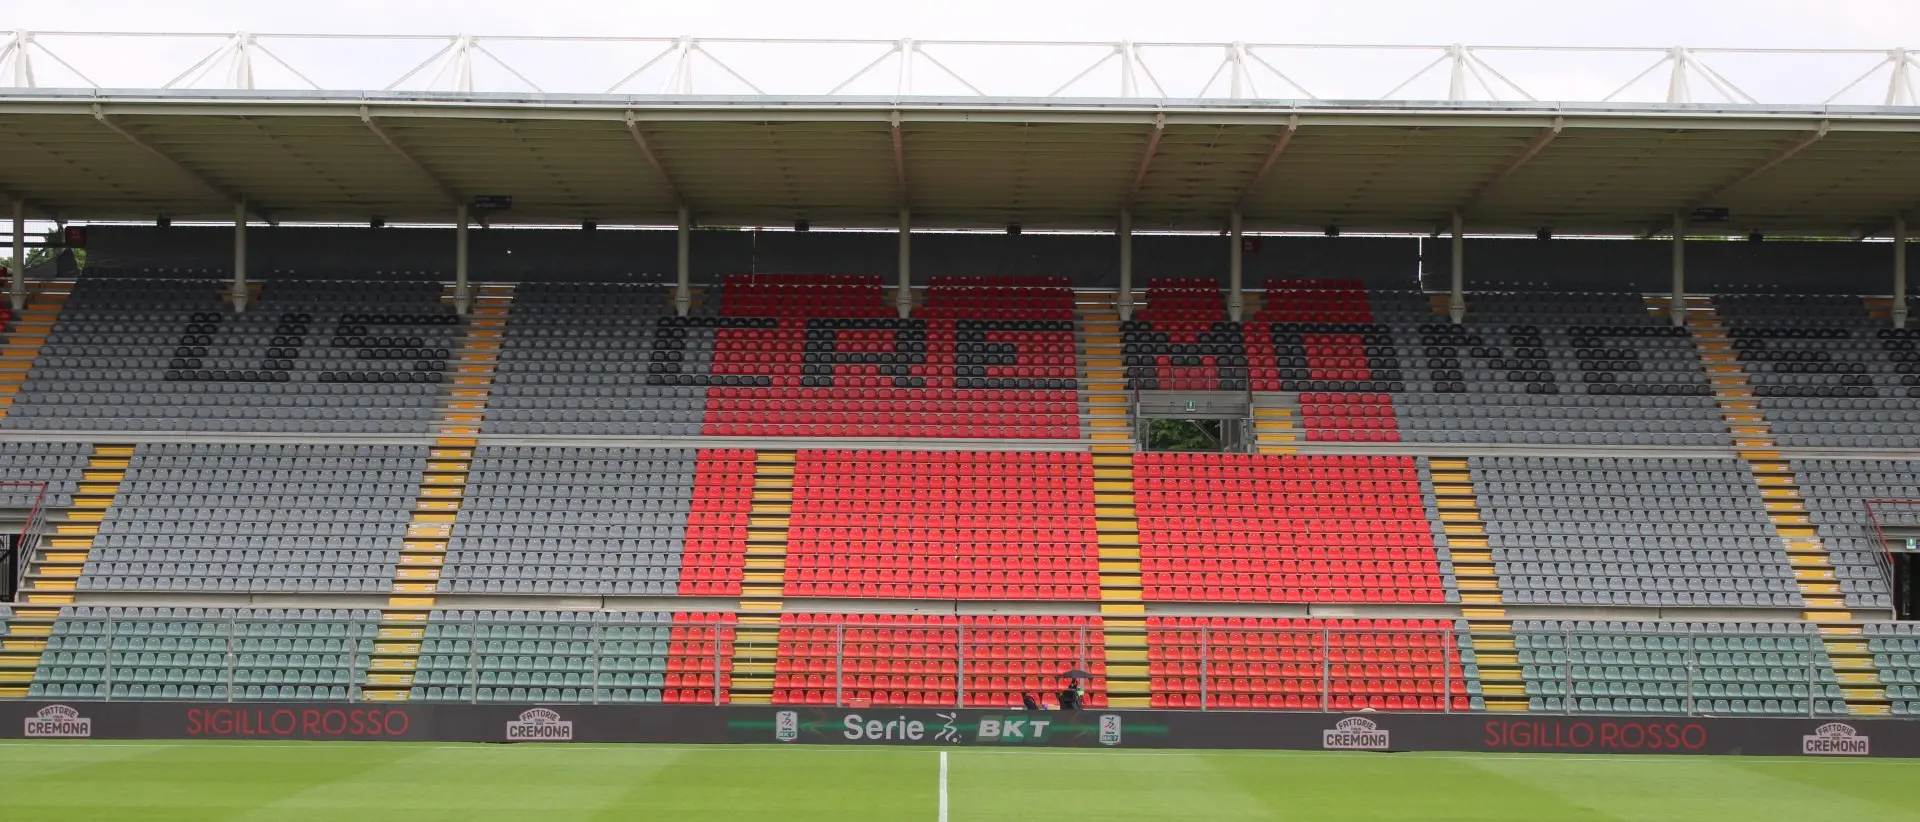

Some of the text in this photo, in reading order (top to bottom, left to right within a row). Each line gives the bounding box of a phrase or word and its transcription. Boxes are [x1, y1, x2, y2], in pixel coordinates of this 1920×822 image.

[40, 706, 77, 718] FATTORIE
[521, 709, 558, 721] FATTORIE
[27, 722, 89, 734] CREMONA
[187, 709, 409, 735] SIGILLO ROSSO
[843, 714, 1050, 741] Serie BKT
[1338, 718, 1374, 730] FATTORIE
[509, 725, 570, 738] CREMONA
[1485, 720, 1707, 749] SIGILLO ROSSO
[1817, 724, 1854, 736] FATTORIE
[1326, 733, 1387, 747] CREMONA
[1805, 739, 1866, 753] CREMONA
